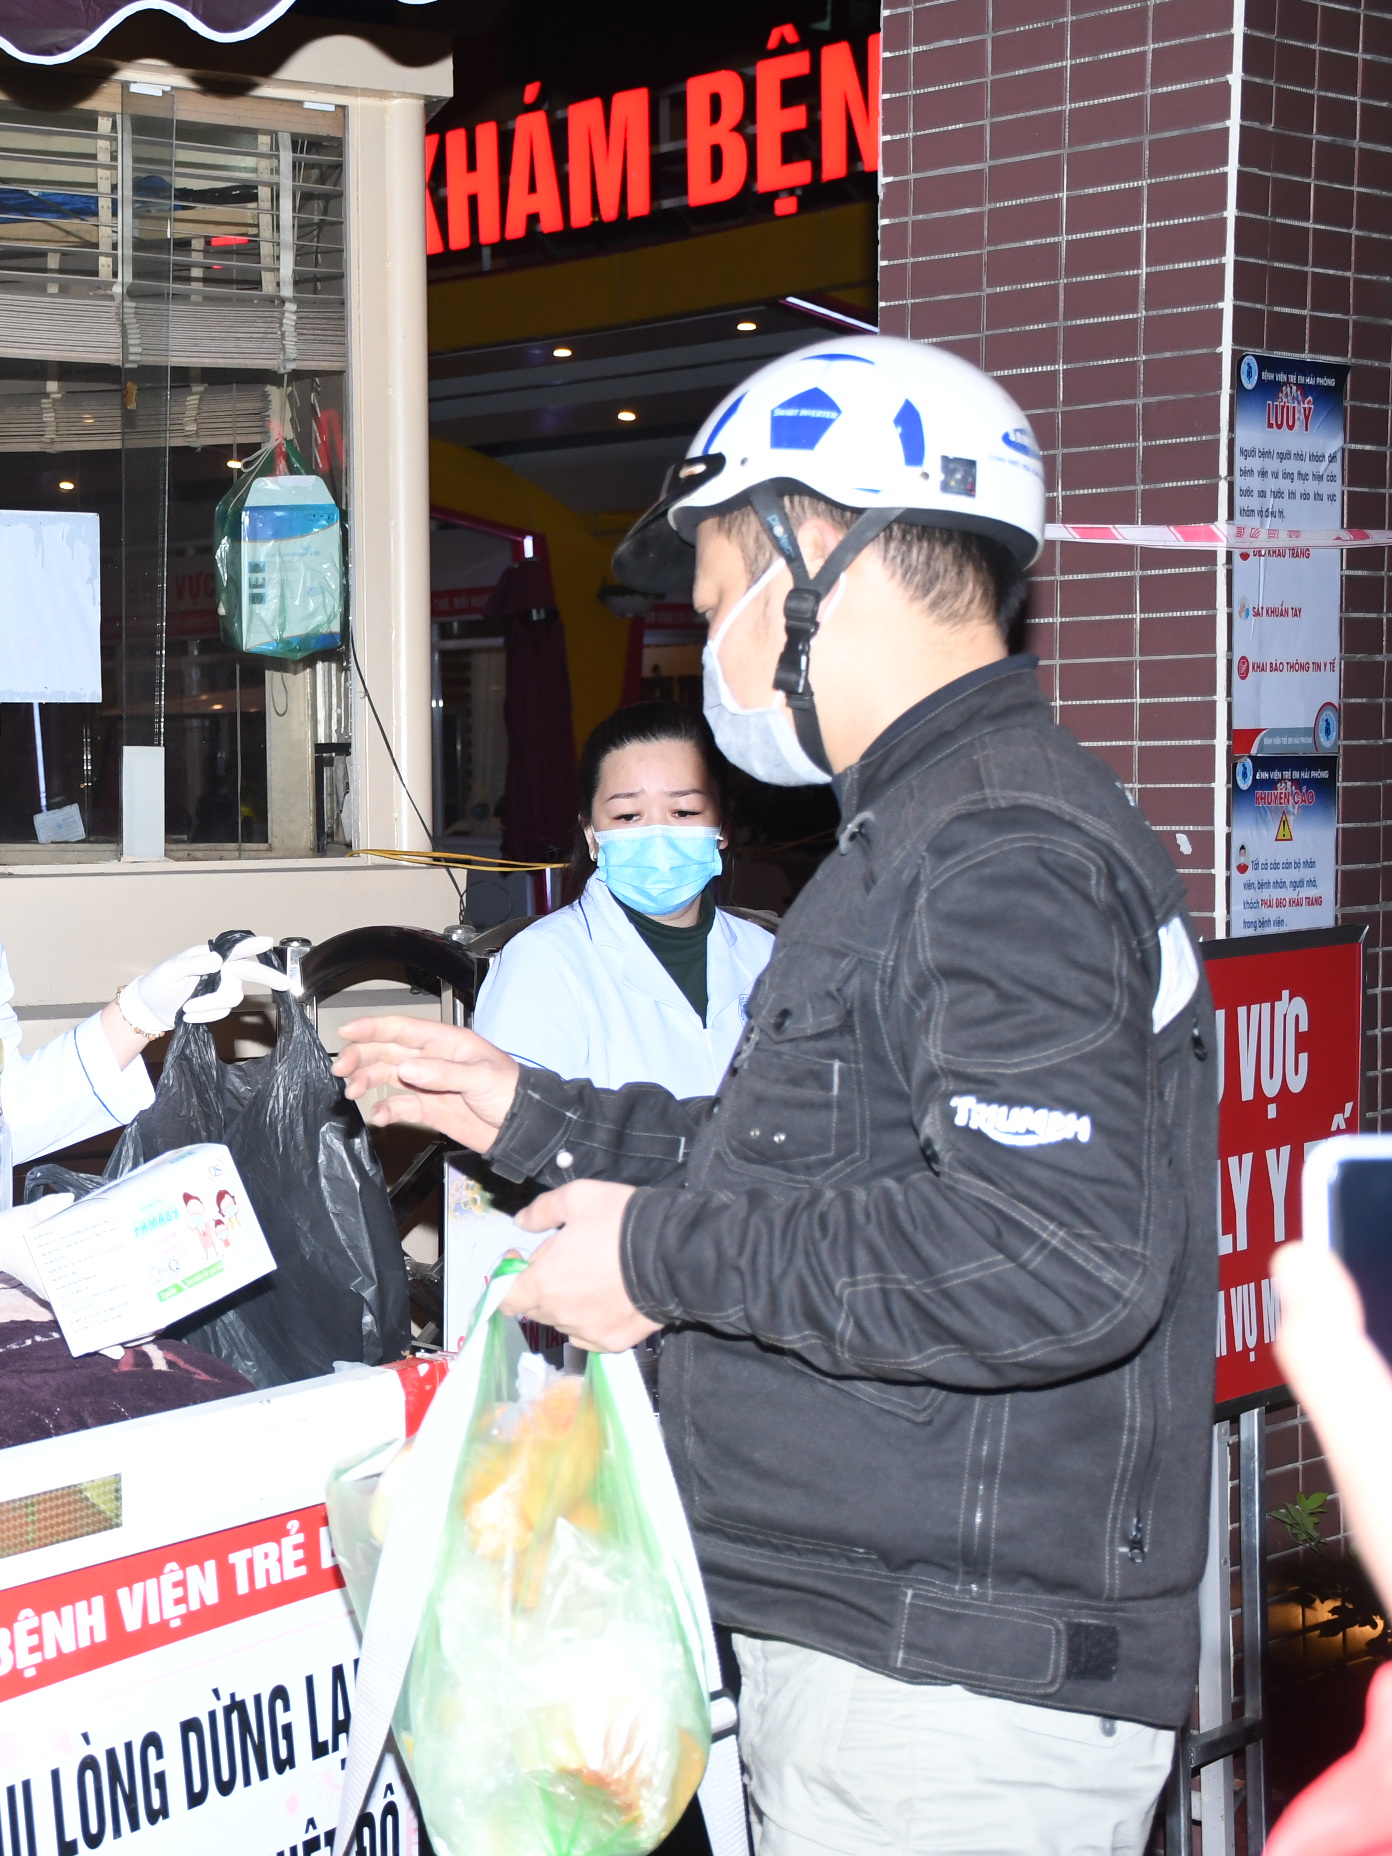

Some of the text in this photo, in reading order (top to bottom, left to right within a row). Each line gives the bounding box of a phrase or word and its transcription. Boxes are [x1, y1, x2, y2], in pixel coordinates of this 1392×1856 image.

[1298, 376, 1304, 384] EM
[1316, 376, 1336, 386] PHÒNG
[1266, 396, 1314, 432] LƯU Ý
[1240, 446, 1256, 460] Người
[1276, 448, 1292, 463] người
[1308, 450, 1326, 462] khách
[1240, 466, 1254, 480] bệnh
[1256, 467, 1268, 482] viện
[1270, 468, 1279, 480] vui
[1282, 468, 1294, 483] lòng
[1326, 470, 1336, 482] các
[1240, 486, 1254, 498] bước
[1258, 490, 1266, 498] sau
[1288, 488, 1296, 500] khi
[1300, 489, 1310, 500] vào
[1314, 490, 1324, 502] khu
[1240, 506, 1256, 518] khám
[1288, 548, 1310, 559] TRANG
[1290, 606, 1302, 618] TAY
[1252, 662, 1268, 672] KHAI
[1269, 658, 1284, 672] BÁO
[1286, 658, 1310, 672] THÔNG
[1312, 662, 1322, 672] TIN
[1329, 657, 1336, 672] TẾ
[1292, 771, 1300, 780] EM
[1310, 768, 1328, 779] PHÒNG
[1293, 786, 1316, 806] CÁO
[1270, 858, 1280, 870] các
[1294, 858, 1301, 872] bộ
[1302, 858, 1316, 869] nhân
[1258, 878, 1271, 892] bệnh
[1289, 877, 1304, 891] người
[1243, 898, 1260, 910] khách
[1260, 894, 1274, 908] PHẢI
[1304, 896, 1322, 906] TRANG
[1243, 918, 1258, 931] trong
[1258, 916, 1271, 930] bệnh
[1237, 989, 1308, 1119] VỰC
[1265, 1144, 1290, 1242] Y
[1230, 1282, 1258, 1362] VỤ
[117, 1561, 219, 1633] VIỆN
[228, 1520, 308, 1595] TRẺ
[50, 1730, 172, 1856] LÒNG
[179, 1684, 296, 1810] DỪNG
[305, 1657, 361, 1772] LẠ
